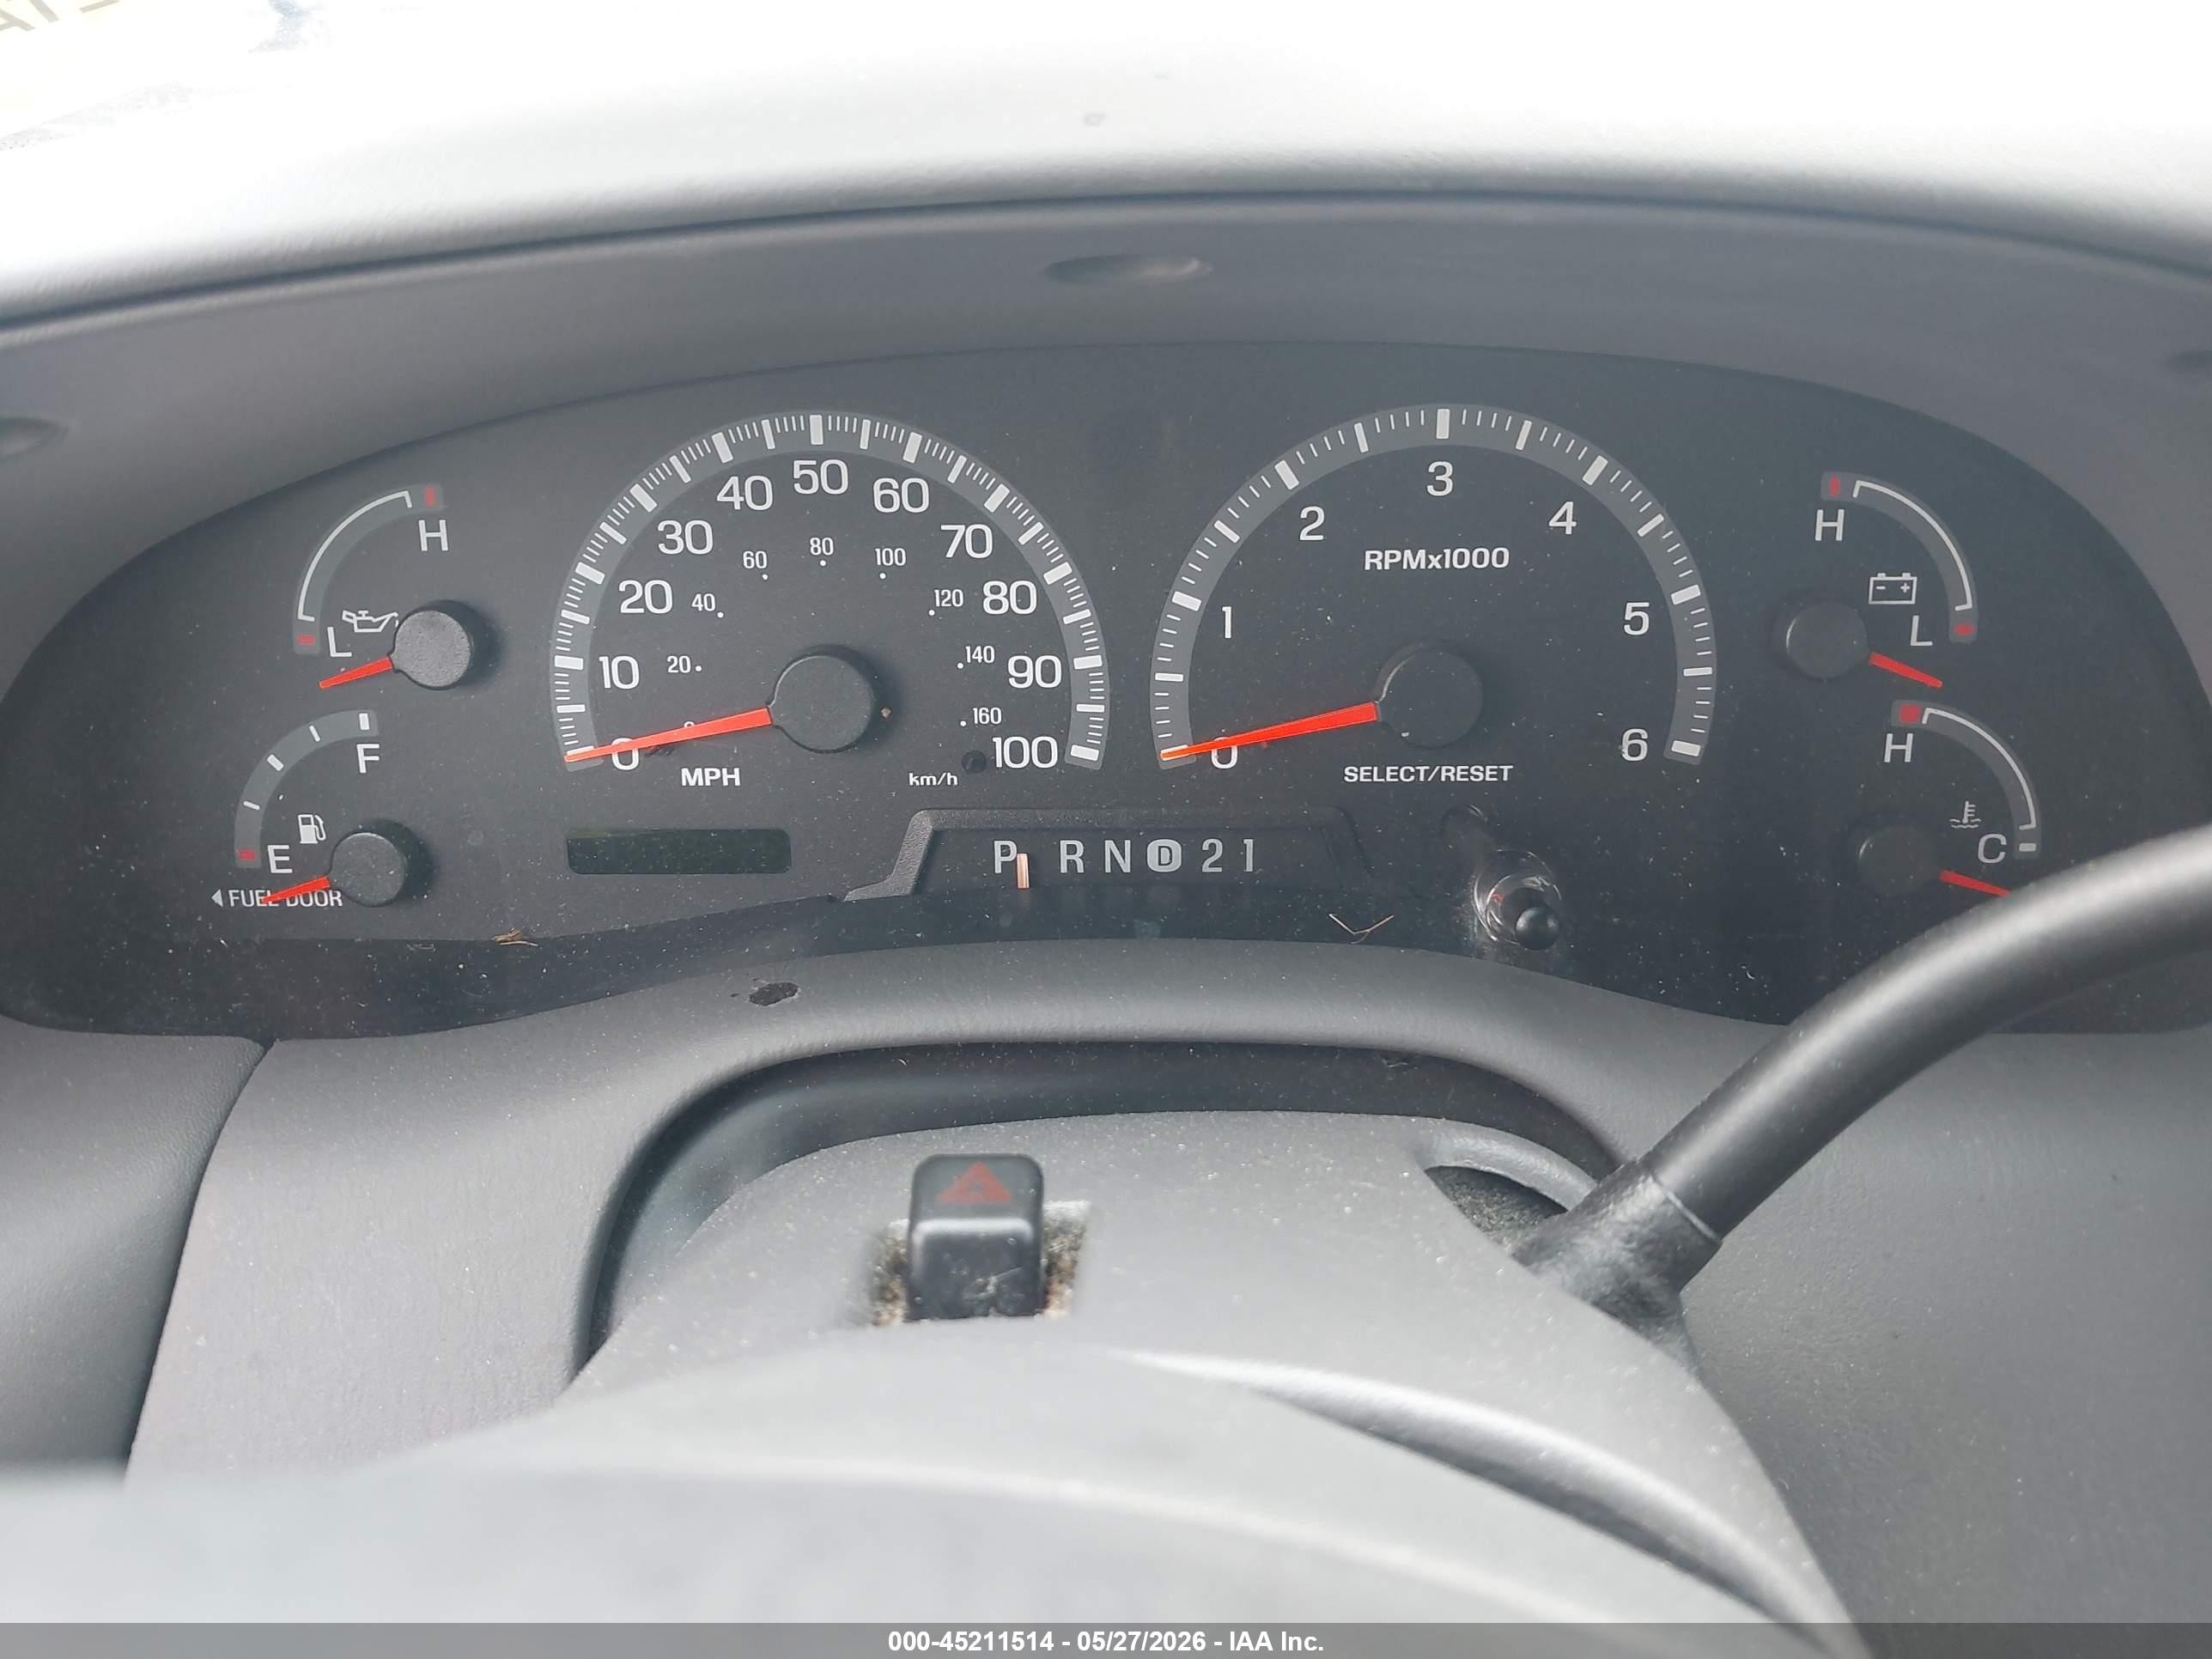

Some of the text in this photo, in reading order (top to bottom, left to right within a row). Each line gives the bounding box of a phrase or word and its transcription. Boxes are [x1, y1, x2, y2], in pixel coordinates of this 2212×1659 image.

[716, 475, 773, 511] 40
[793, 459, 848, 495] 50
[1426, 461, 1453, 496] 3
[872, 477, 930, 514] 60
[1299, 506, 1325, 541] 2
[1548, 501, 1577, 535] 4
[1814, 508, 1844, 542] H
[418, 520, 449, 551] H
[657, 520, 714, 555] 30
[810, 537, 834, 556] 80
[940, 524, 993, 559] 70
[743, 550, 768, 569] 60
[875, 548, 907, 567] 100
[1364, 547, 1510, 570] RPMx1000
[618, 580, 673, 614] 20
[691, 593, 716, 611] 40
[933, 588, 964, 607] 120
[982, 580, 1037, 615] 80
[1221, 605, 1232, 639] 1
[1624, 602, 1650, 635] 5
[1910, 615, 1933, 647] L
[327, 626, 352, 658] L
[965, 645, 995, 664] 140
[599, 655, 640, 690] 10
[666, 655, 691, 673] 20
[1007, 654, 1062, 689] 90
[972, 707, 1002, 725] 160
[356, 743, 380, 774] F
[611, 737, 640, 771] 0
[992, 736, 1058, 769] 100
[1211, 736, 1238, 769] 0
[1621, 728, 1649, 762] 6
[1884, 732, 1914, 763] H
[681, 767, 741, 787] MPH
[908, 772, 958, 787] km/h
[1344, 765, 1514, 782] SELECT/RESET
[267, 844, 293, 874] E
[994, 840, 1018, 874] P
[1060, 840, 1085, 873] R
[1104, 839, 1131, 873] N
[1201, 838, 1223, 872] 2
[1243, 838, 1254, 872] 1
[1978, 833, 2007, 864] C
